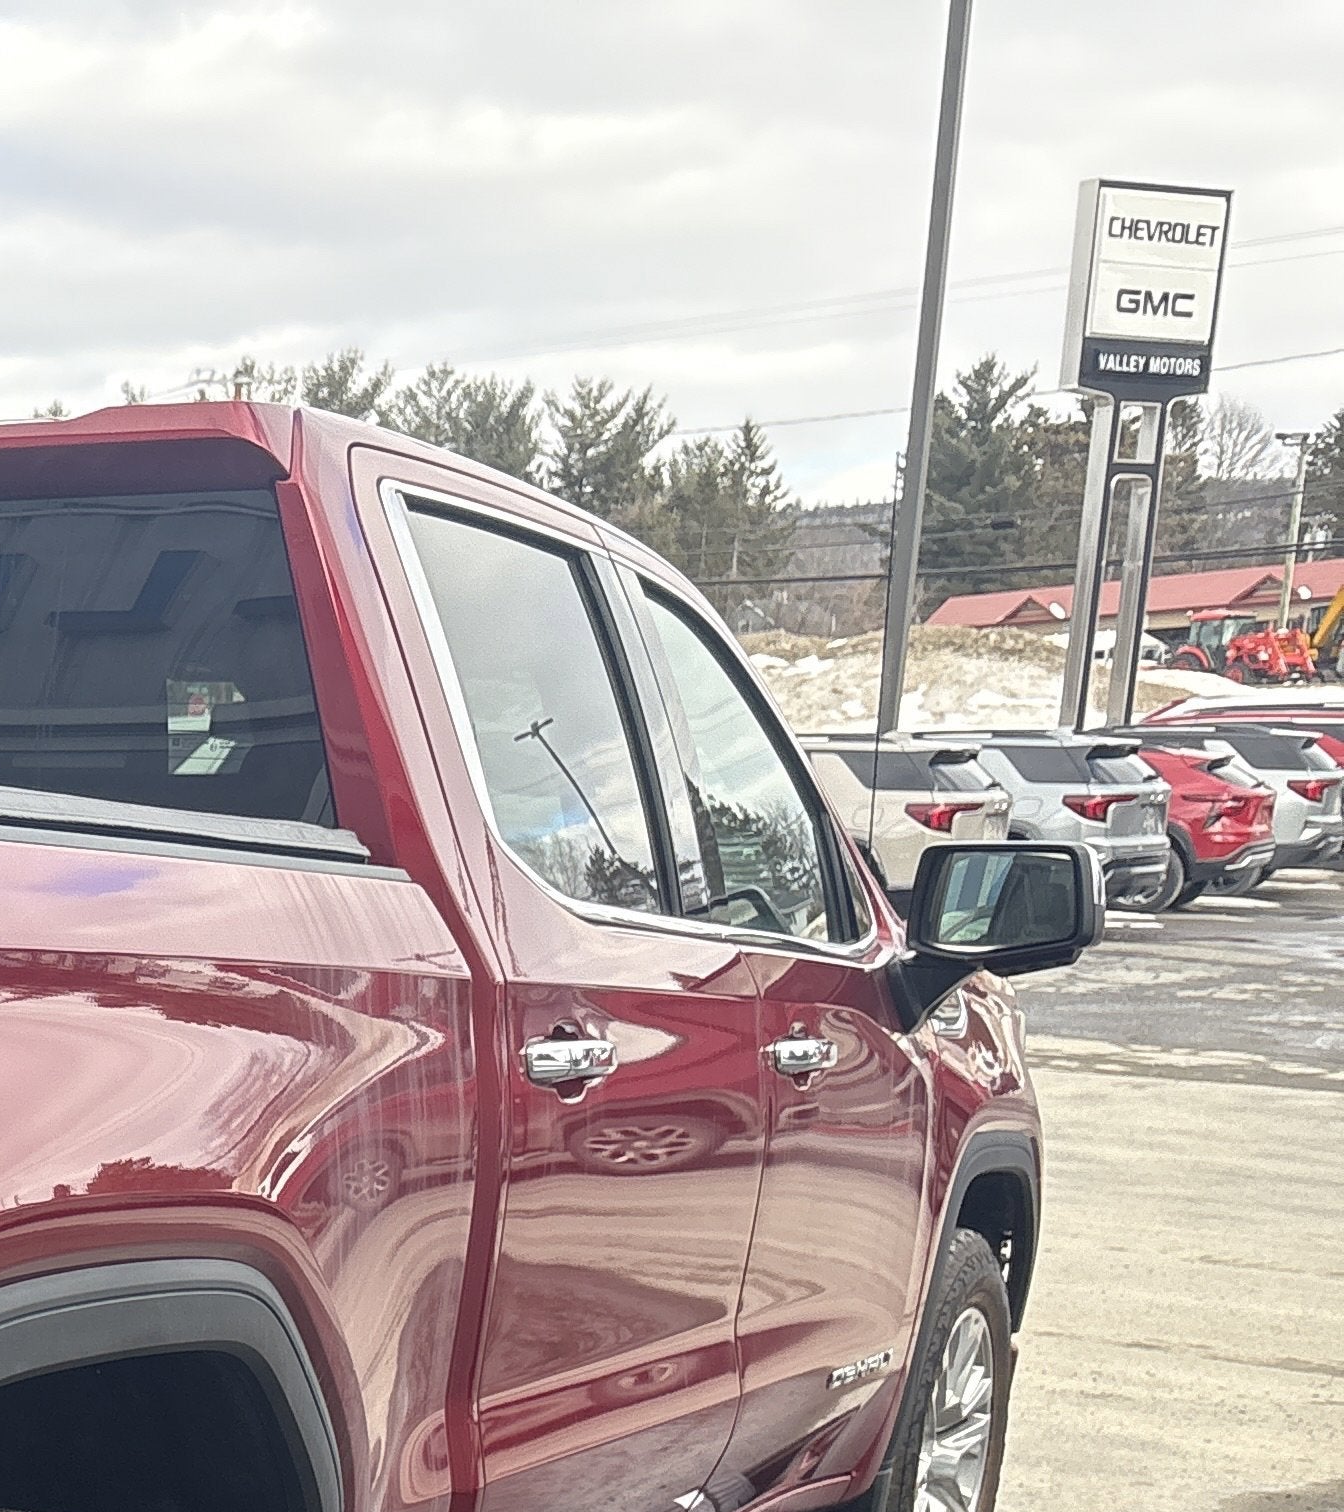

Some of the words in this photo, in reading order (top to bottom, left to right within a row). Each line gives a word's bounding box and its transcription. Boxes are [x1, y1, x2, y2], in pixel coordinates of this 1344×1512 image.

[1108, 215, 1220, 247] CHEVROLET
[1116, 288, 1195, 318] GMC
[1098, 352, 1146, 374] VALLEY
[1149, 356, 1201, 377] MOTORS
